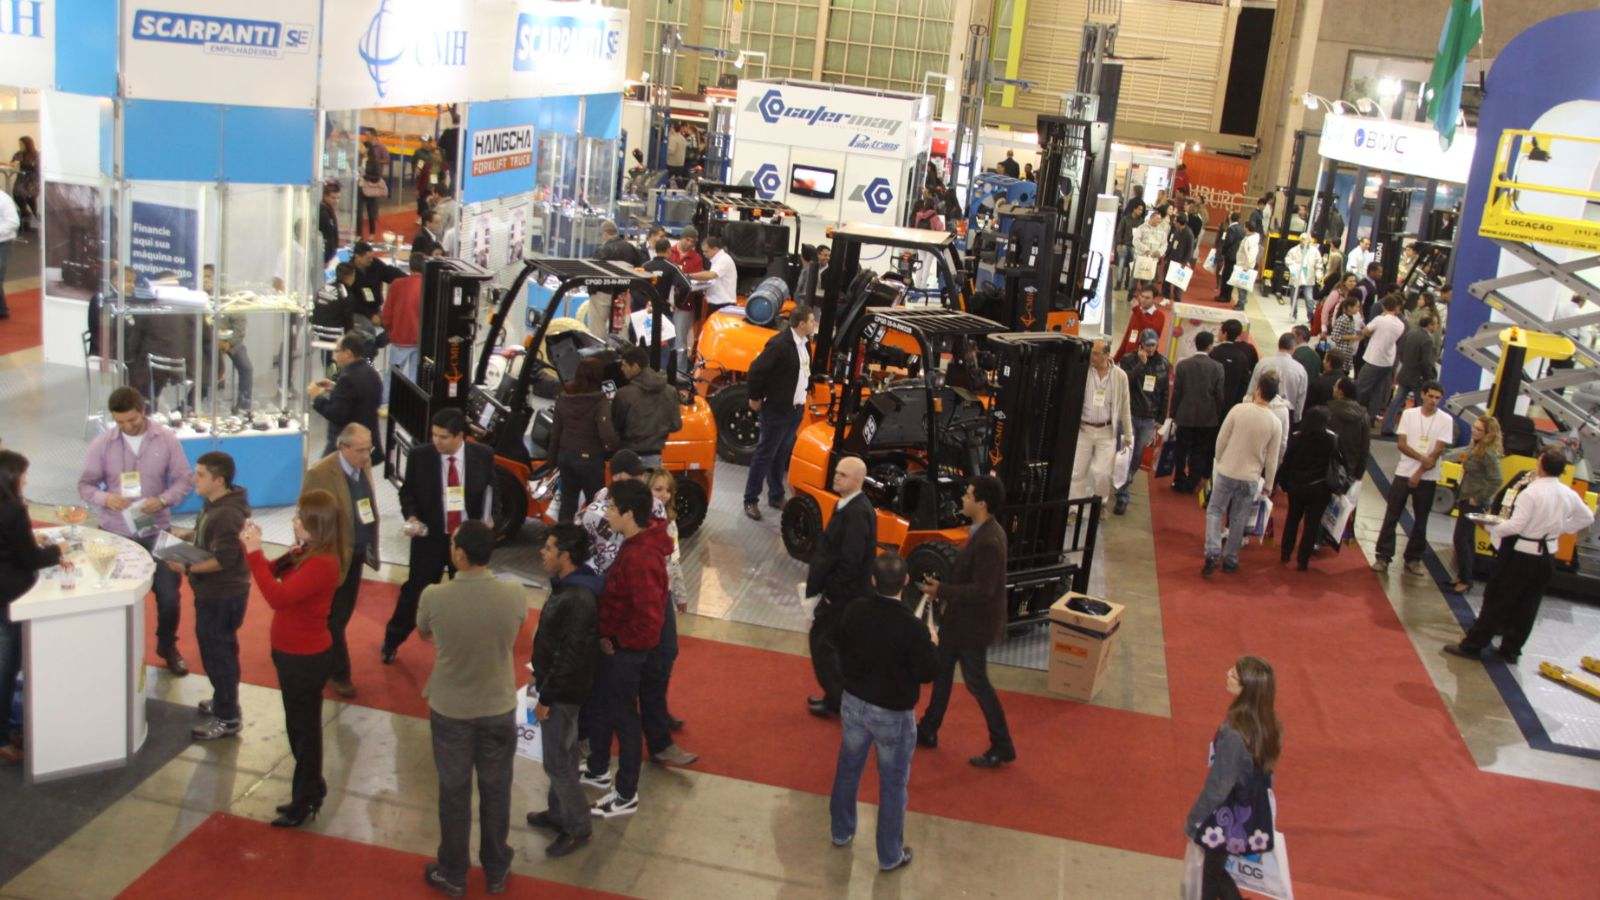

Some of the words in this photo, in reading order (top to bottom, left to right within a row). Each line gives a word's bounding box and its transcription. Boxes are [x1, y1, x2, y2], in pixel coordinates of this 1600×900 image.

[139, 15, 276, 46] SCARPANTI
[210, 45, 278, 58] EMPILHADEIRAS
[475, 129, 531, 156] HANGCHA
[1366, 131, 1408, 154] BMC
[473, 158, 507, 175] FORKLIFT
[512, 154, 531, 169] TRUCK
[133, 222, 171, 237] Financie
[133, 237, 153, 249] aqui
[155, 240, 170, 249] sua
[133, 250, 172, 262] máquina
[174, 256, 186, 264] ou
[1238, 862, 1264, 879] LOG
